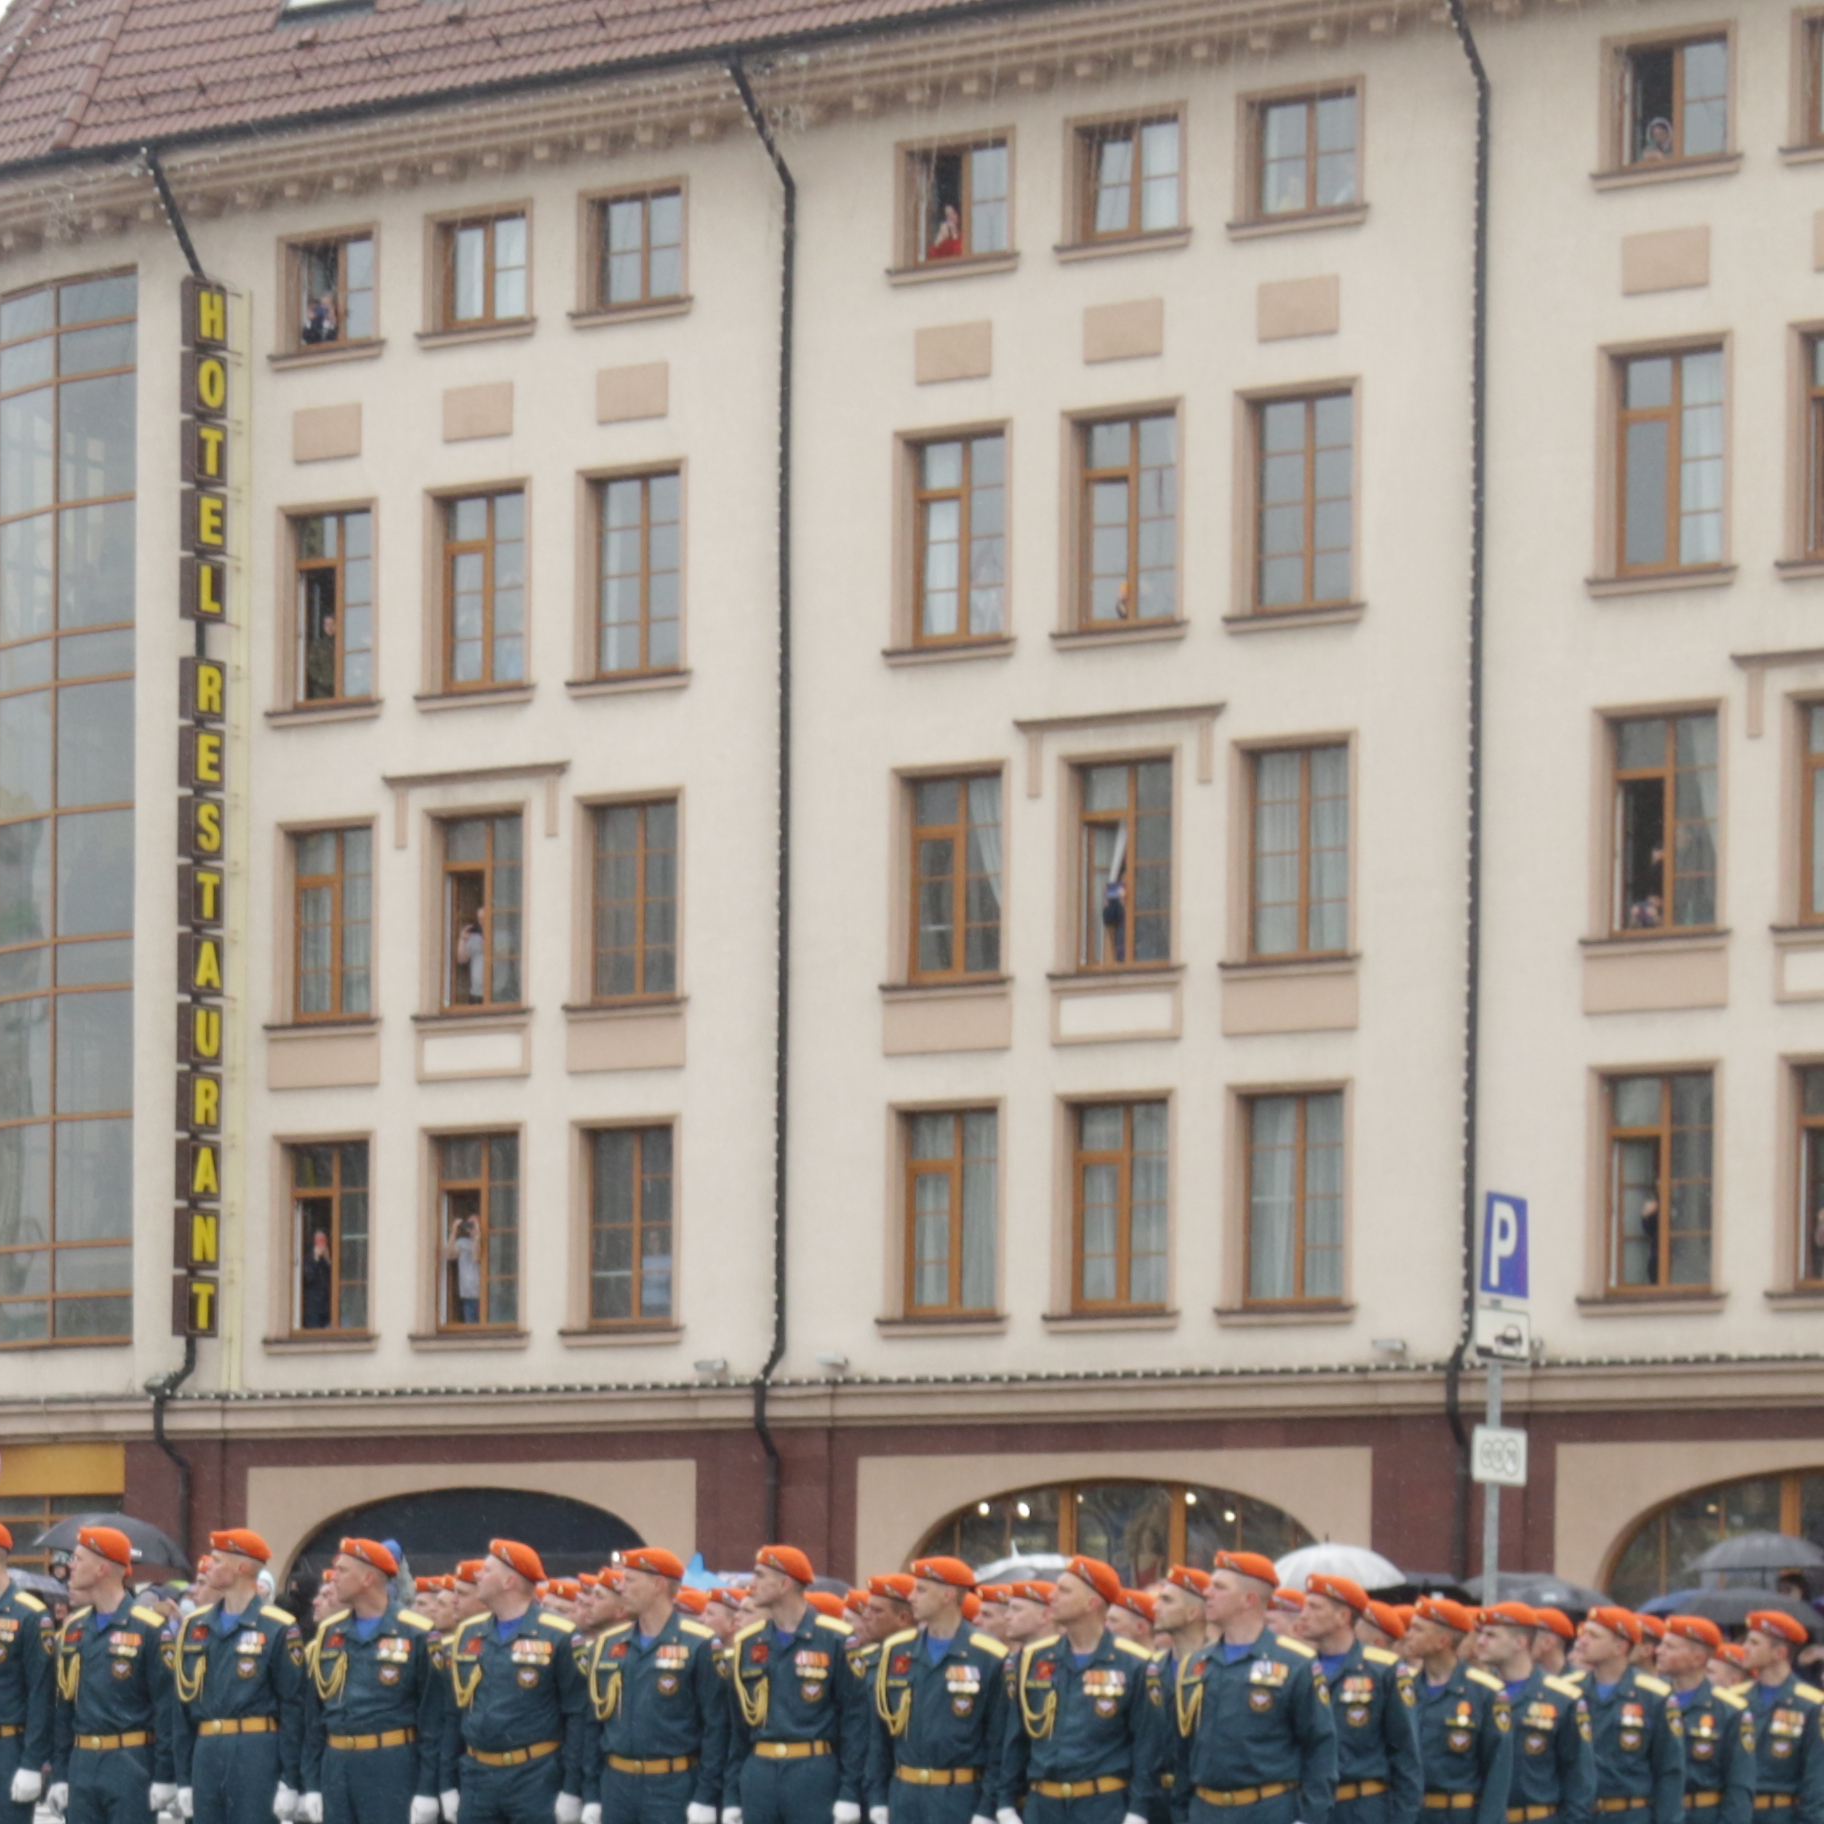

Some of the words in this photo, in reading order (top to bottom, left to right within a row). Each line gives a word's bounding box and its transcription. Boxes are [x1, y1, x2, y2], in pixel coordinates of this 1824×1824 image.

[198, 291, 226, 614] HOTEL
[191, 664, 223, 1330] RESTAURANT
[1489, 1201, 1517, 1287] P
